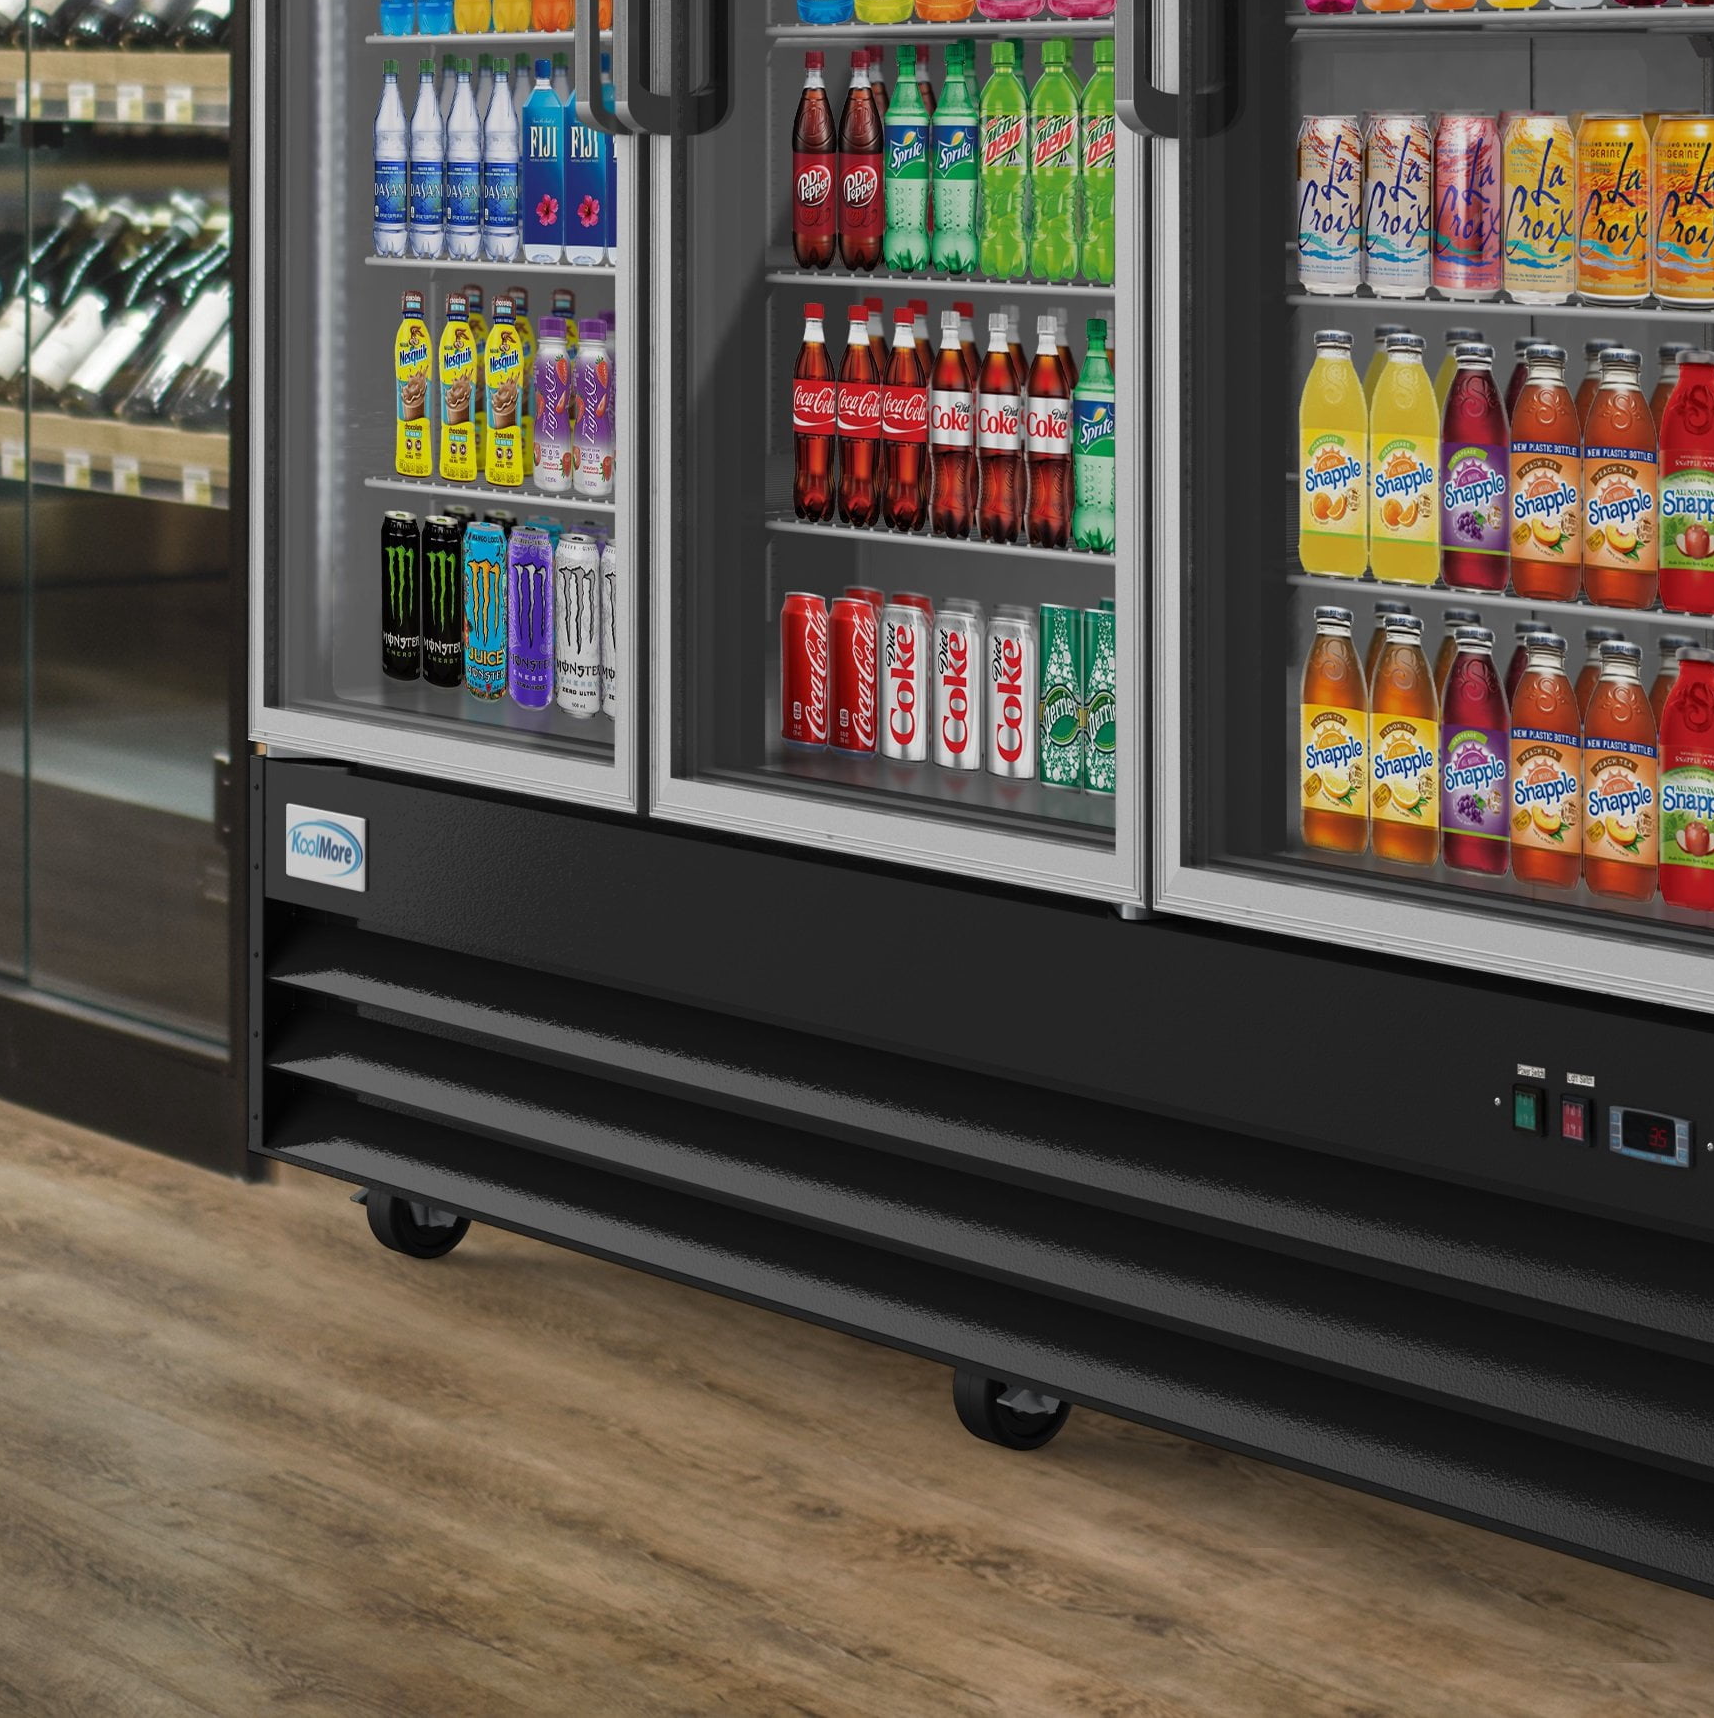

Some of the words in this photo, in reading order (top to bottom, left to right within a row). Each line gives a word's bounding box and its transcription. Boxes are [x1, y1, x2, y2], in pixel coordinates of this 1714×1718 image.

[529, 126, 558, 158] FIJI
[570, 126, 599, 159] FIJI
[891, 141, 923, 169] Sprite
[937, 142, 971, 170] Sprite
[1321, 135, 1354, 200] La
[1389, 135, 1422, 202] La
[1531, 137, 1566, 207] La
[1607, 142, 1642, 208] La
[798, 175, 830, 202] Pepper
[844, 175, 876, 203] Pepper
[1298, 180, 1362, 252] Croix
[1367, 181, 1431, 252] Croix
[1504, 184, 1574, 256] Croix
[1578, 189, 1647, 259] Croix
[399, 346, 428, 367] Nesquik
[444, 350, 472, 370] Nesquik
[490, 352, 520, 372] Nesquik
[931, 403, 970, 432] Coke
[955, 400, 971, 413] Diet
[1002, 404, 1018, 417] Diet
[1052, 408, 1068, 421] Diet
[978, 407, 1018, 436] Coke
[1026, 412, 1067, 439] Coke
[1080, 415, 1114, 444] Sprite
[1512, 442, 1527, 452] NEW
[1528, 443, 1553, 455] PLASTIC
[1553, 445, 1578, 457] BOTTLE!
[1587, 448, 1602, 458] NEW
[1602, 449, 1628, 460] PLASTIC
[1629, 451, 1654, 463] BOTTLE!
[1305, 456, 1362, 493] Snapple
[1375, 462, 1434, 498] Snapple
[1543, 460, 1558, 471] TEA
[1443, 473, 1505, 511] Snapple
[1514, 483, 1577, 519] Snapple
[1588, 489, 1653, 526] Snapple
[469, 649, 504, 666] JUICE
[805, 600, 827, 740] Coca-Cola
[513, 670, 548, 682] ENERGY
[889, 625, 916, 746] Coke
[562, 687, 577, 696] ZERO
[579, 688, 596, 697] ULTRA
[942, 630, 968, 755] Coke
[996, 637, 1023, 764] Coke
[1512, 729, 1527, 739] NEW
[1528, 730, 1553, 742] PLASTIC
[1553, 733, 1578, 745] BOTTLE!
[1602, 740, 1628, 752] PLASTIC
[1629, 743, 1655, 756] BOTTLE!
[1305, 736, 1363, 769] Snapple
[1374, 745, 1434, 779] Snapple
[291, 831, 352, 864] KoolMore
[1648, 1126, 1668, 1149] 35
